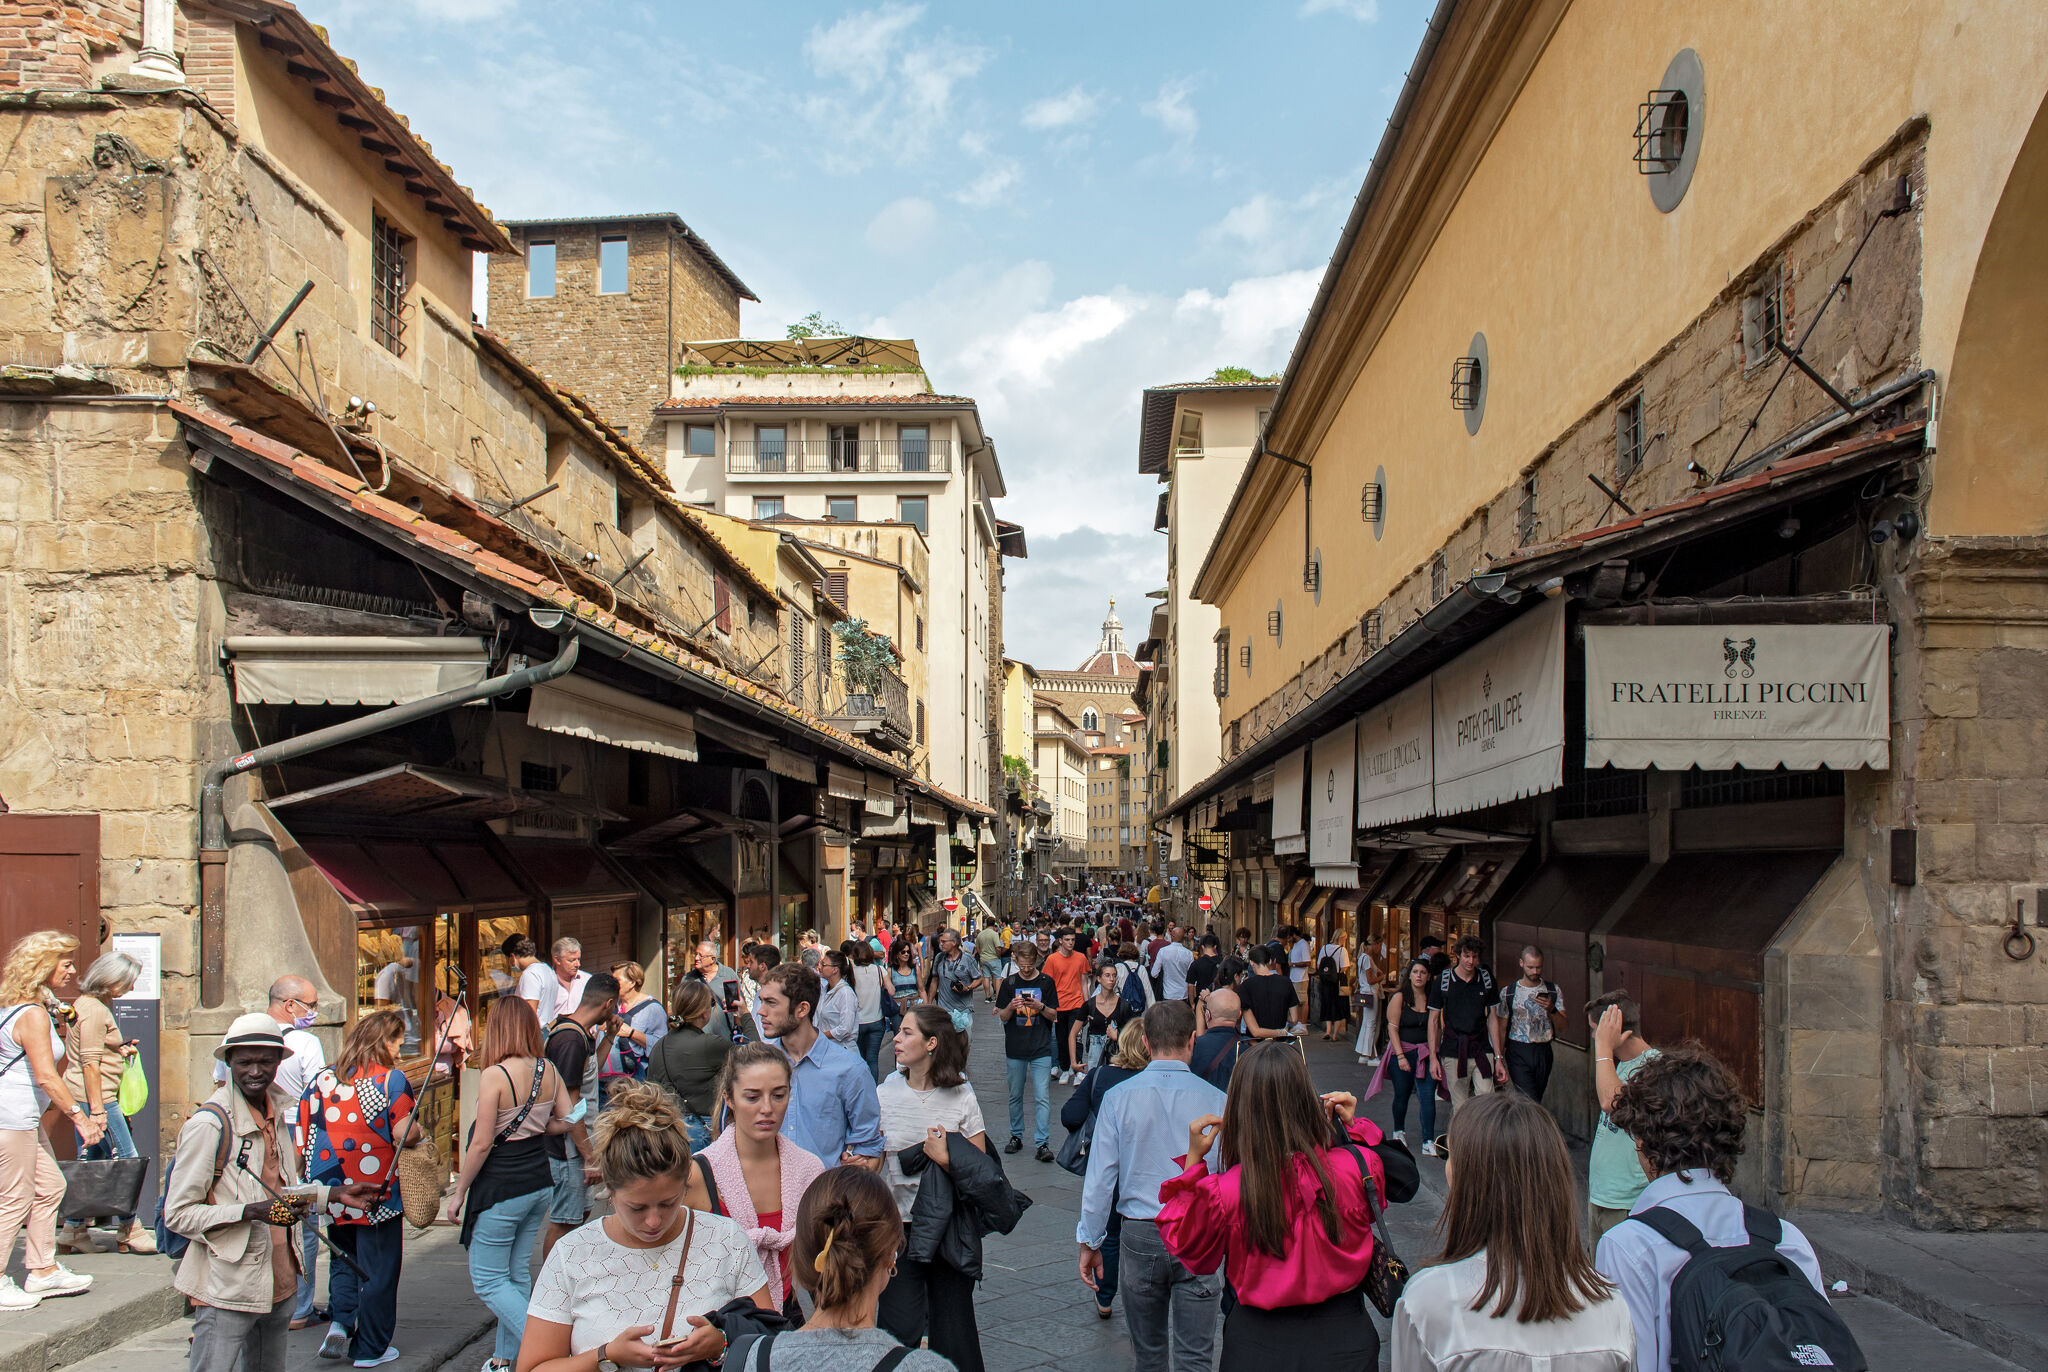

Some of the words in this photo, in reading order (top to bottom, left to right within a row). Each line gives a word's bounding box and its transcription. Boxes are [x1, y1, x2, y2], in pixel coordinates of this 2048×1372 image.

[1610, 682, 1749, 703] FRATELLI
[1757, 682, 1867, 703] PICCINI
[1457, 711, 1482, 747] PATEK
[1482, 692, 1523, 737] PHILIPPE
[1713, 710, 1766, 720] FIRENZE
[1008, 830, 1017, 889] PICCINI
[1790, 1351, 1817, 1360] NORTH
[1796, 1344, 1814, 1353] THE
